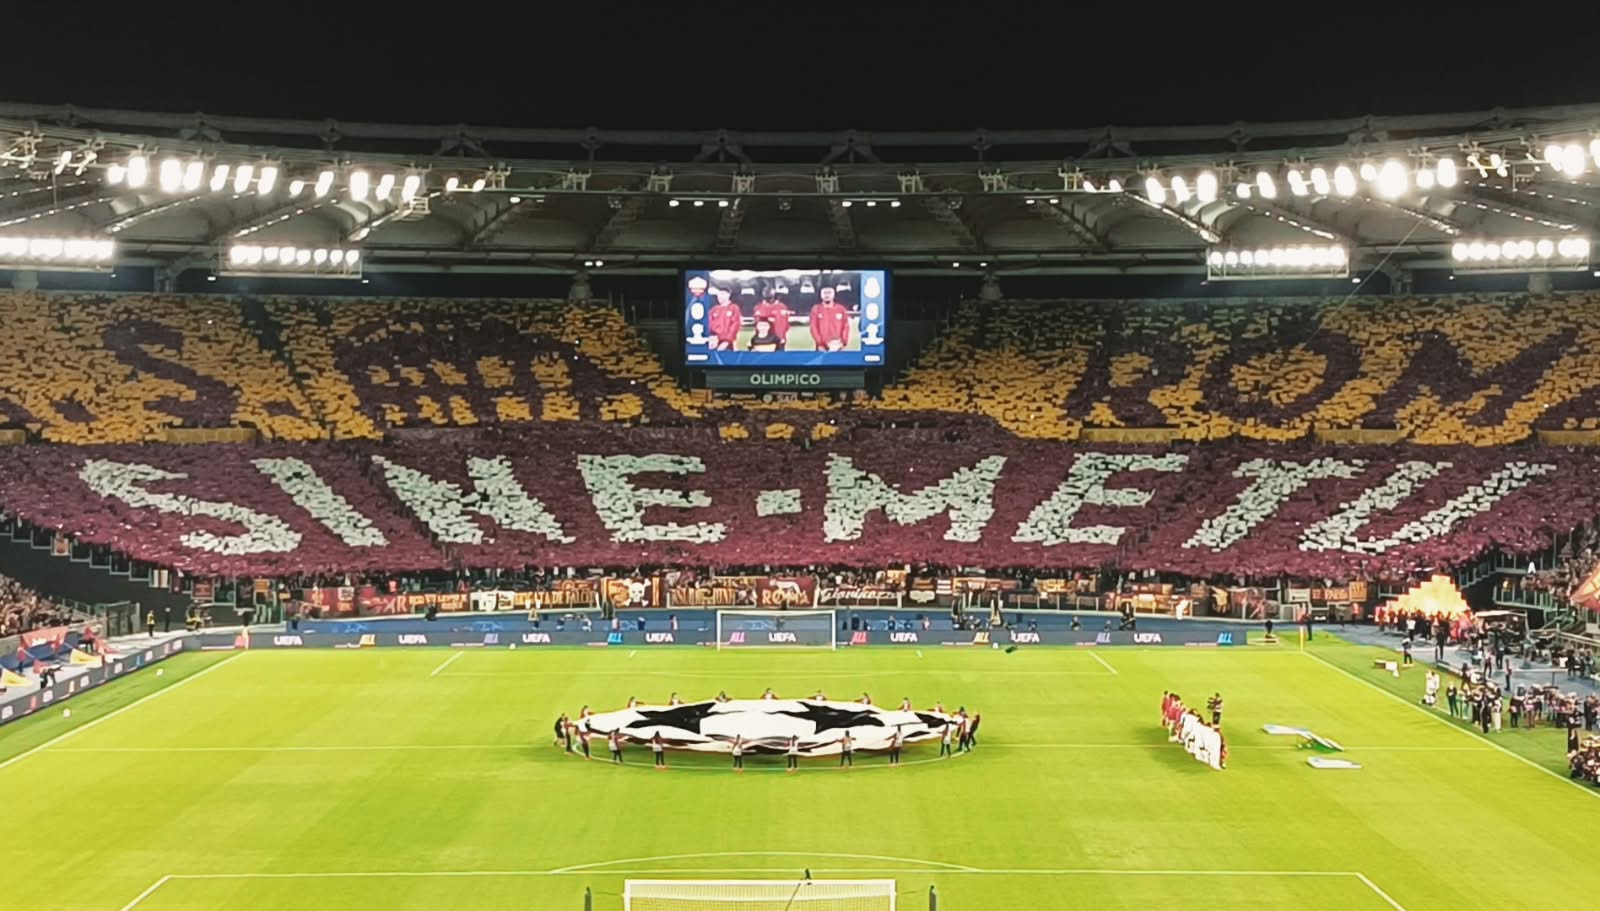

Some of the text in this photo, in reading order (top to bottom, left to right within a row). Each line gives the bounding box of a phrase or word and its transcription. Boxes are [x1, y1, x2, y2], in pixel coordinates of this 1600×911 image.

[750, 373, 821, 385] OLIMPICO
[762, 588, 810, 605] ROMA
[274, 635, 303, 645] UEFA
[398, 634, 428, 645] UEFA
[522, 633, 551, 643] UEFA
[645, 633, 674, 643] UEFA
[768, 633, 797, 643] UEFA
[890, 632, 918, 642] UEFA
[1012, 633, 1040, 643] UEFA
[1133, 632, 1162, 643] UEFA
